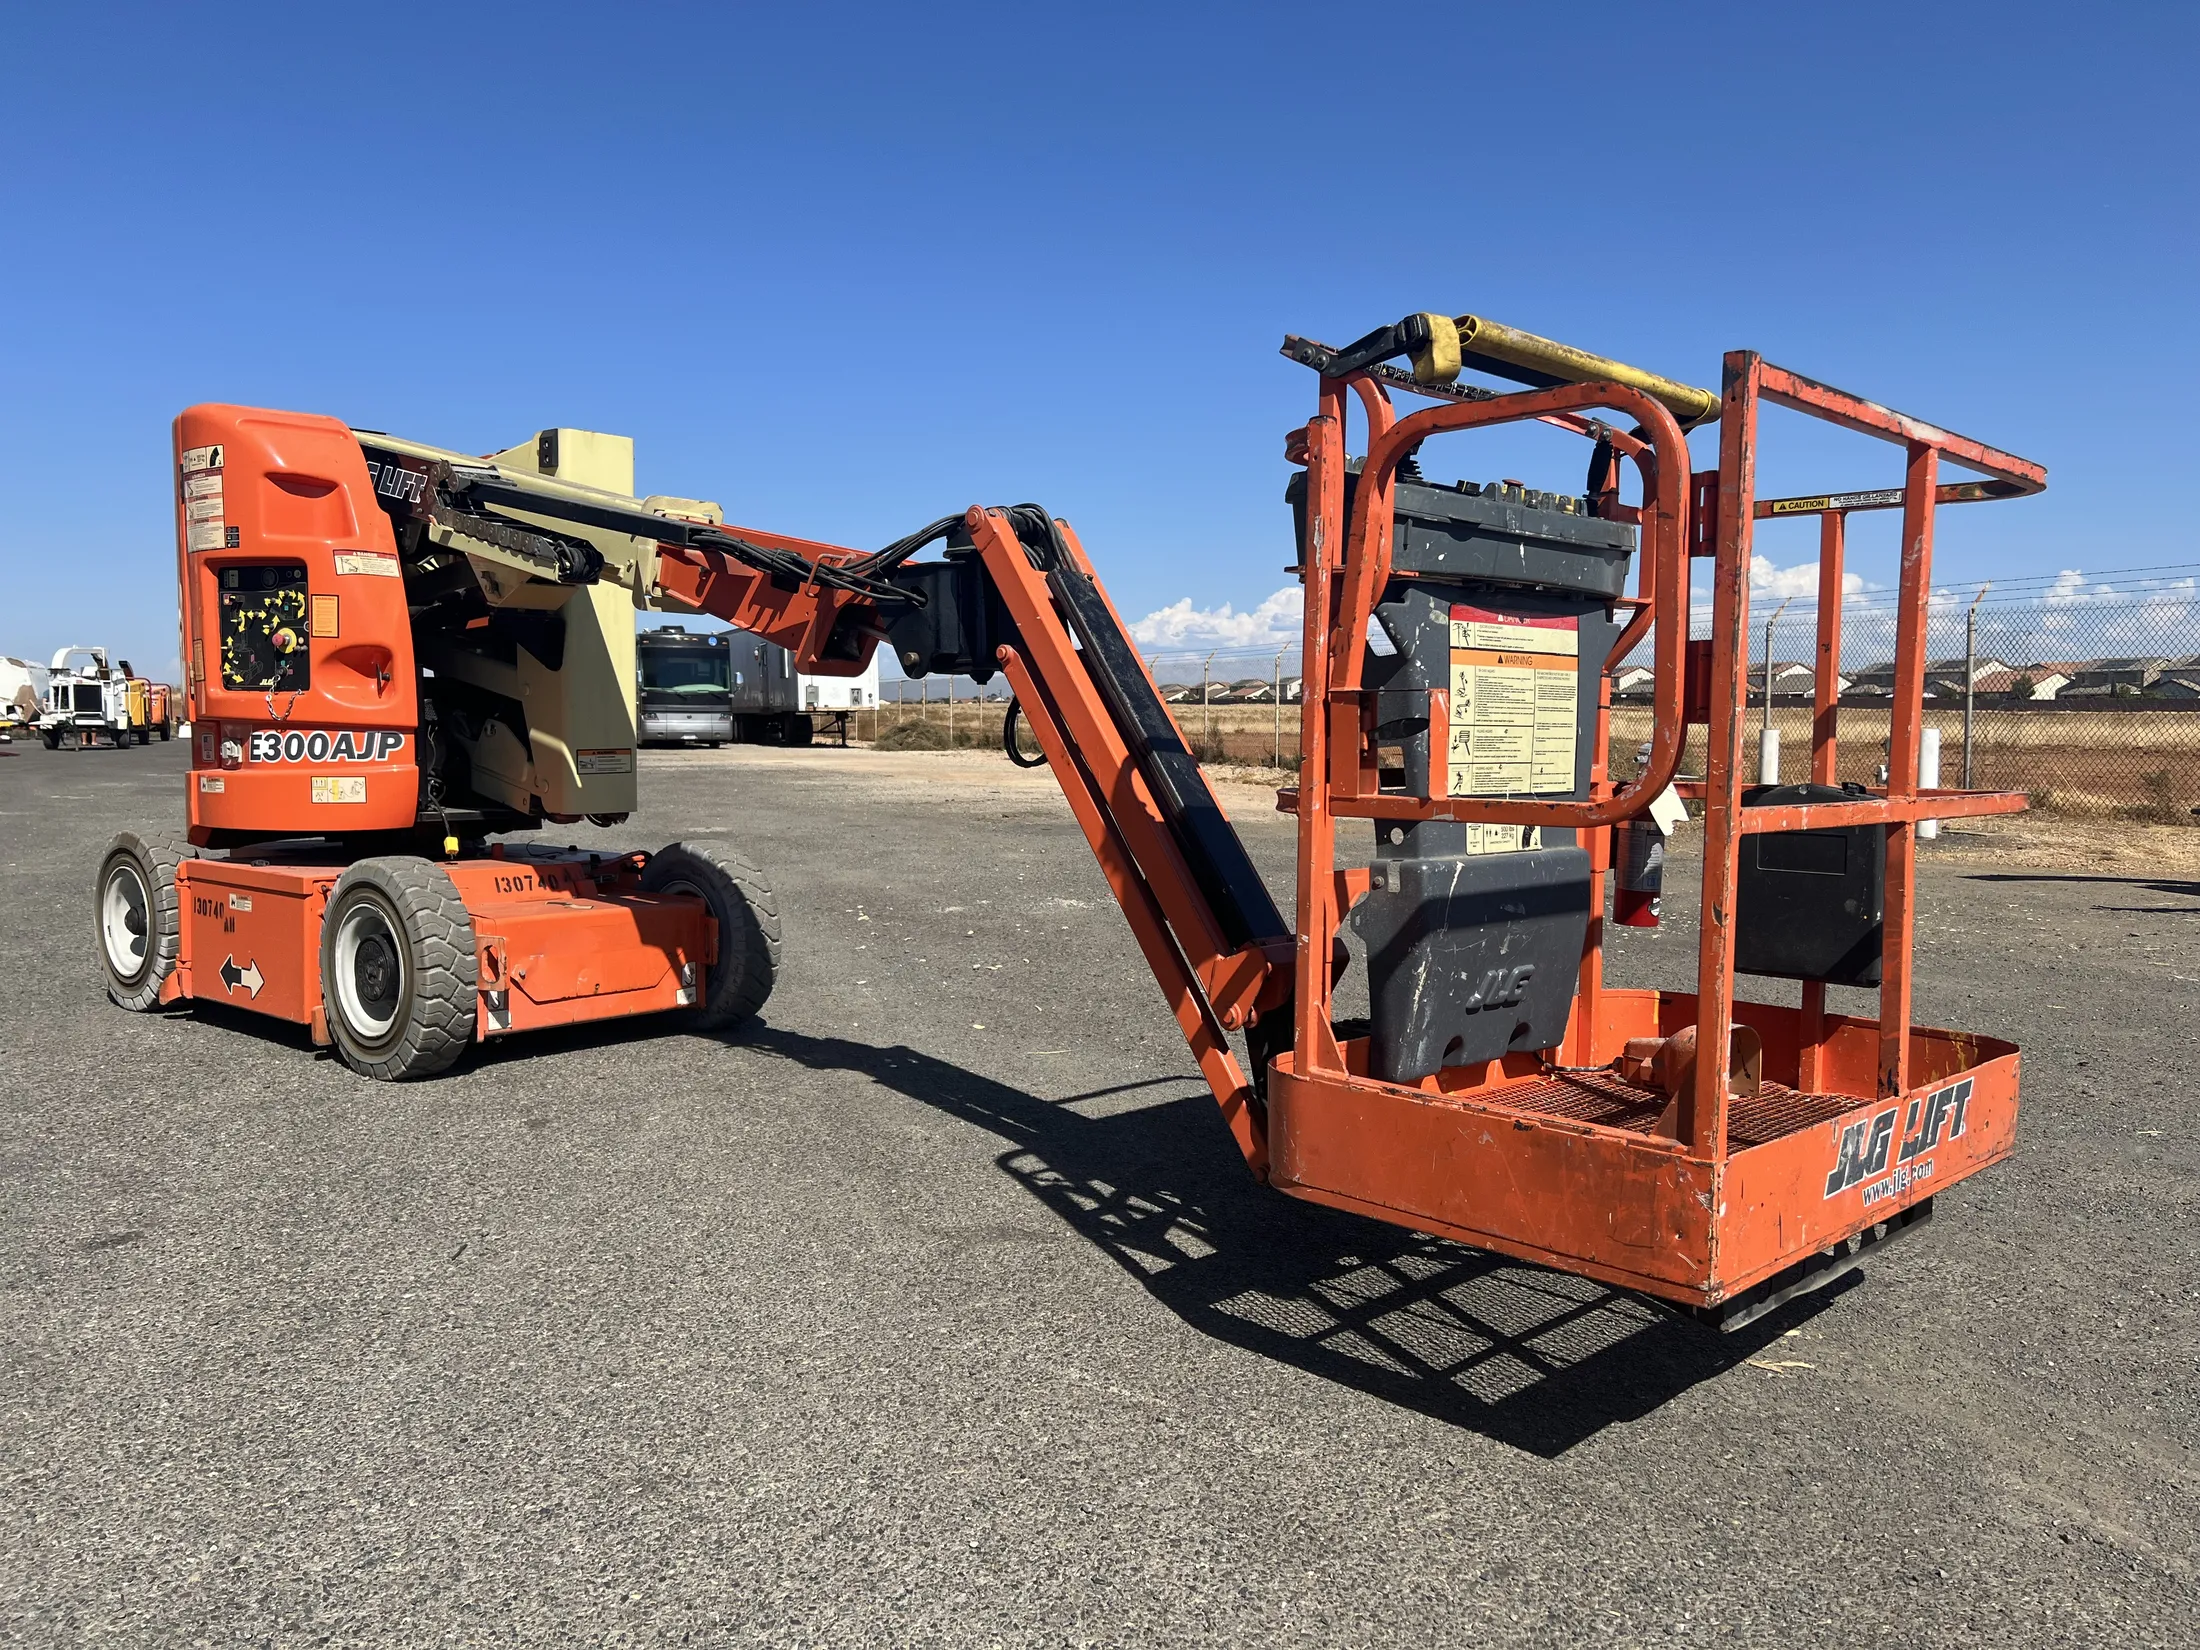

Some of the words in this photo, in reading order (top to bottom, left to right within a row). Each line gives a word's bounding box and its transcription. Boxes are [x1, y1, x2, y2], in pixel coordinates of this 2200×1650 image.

[378, 465, 428, 503] LIFT
[1788, 500, 1824, 509] CAUTION
[1504, 655, 1533, 667] WARNING
[249, 730, 405, 763] E300AJP
[494, 875, 559, 893] 130740
[193, 896, 225, 920] 130740
[1465, 964, 1536, 1015] JLG
[1823, 1107, 1899, 1200] JLG
[1897, 1076, 1975, 1165] LIFT
[1862, 1158, 1934, 1207] www.jlg.com
